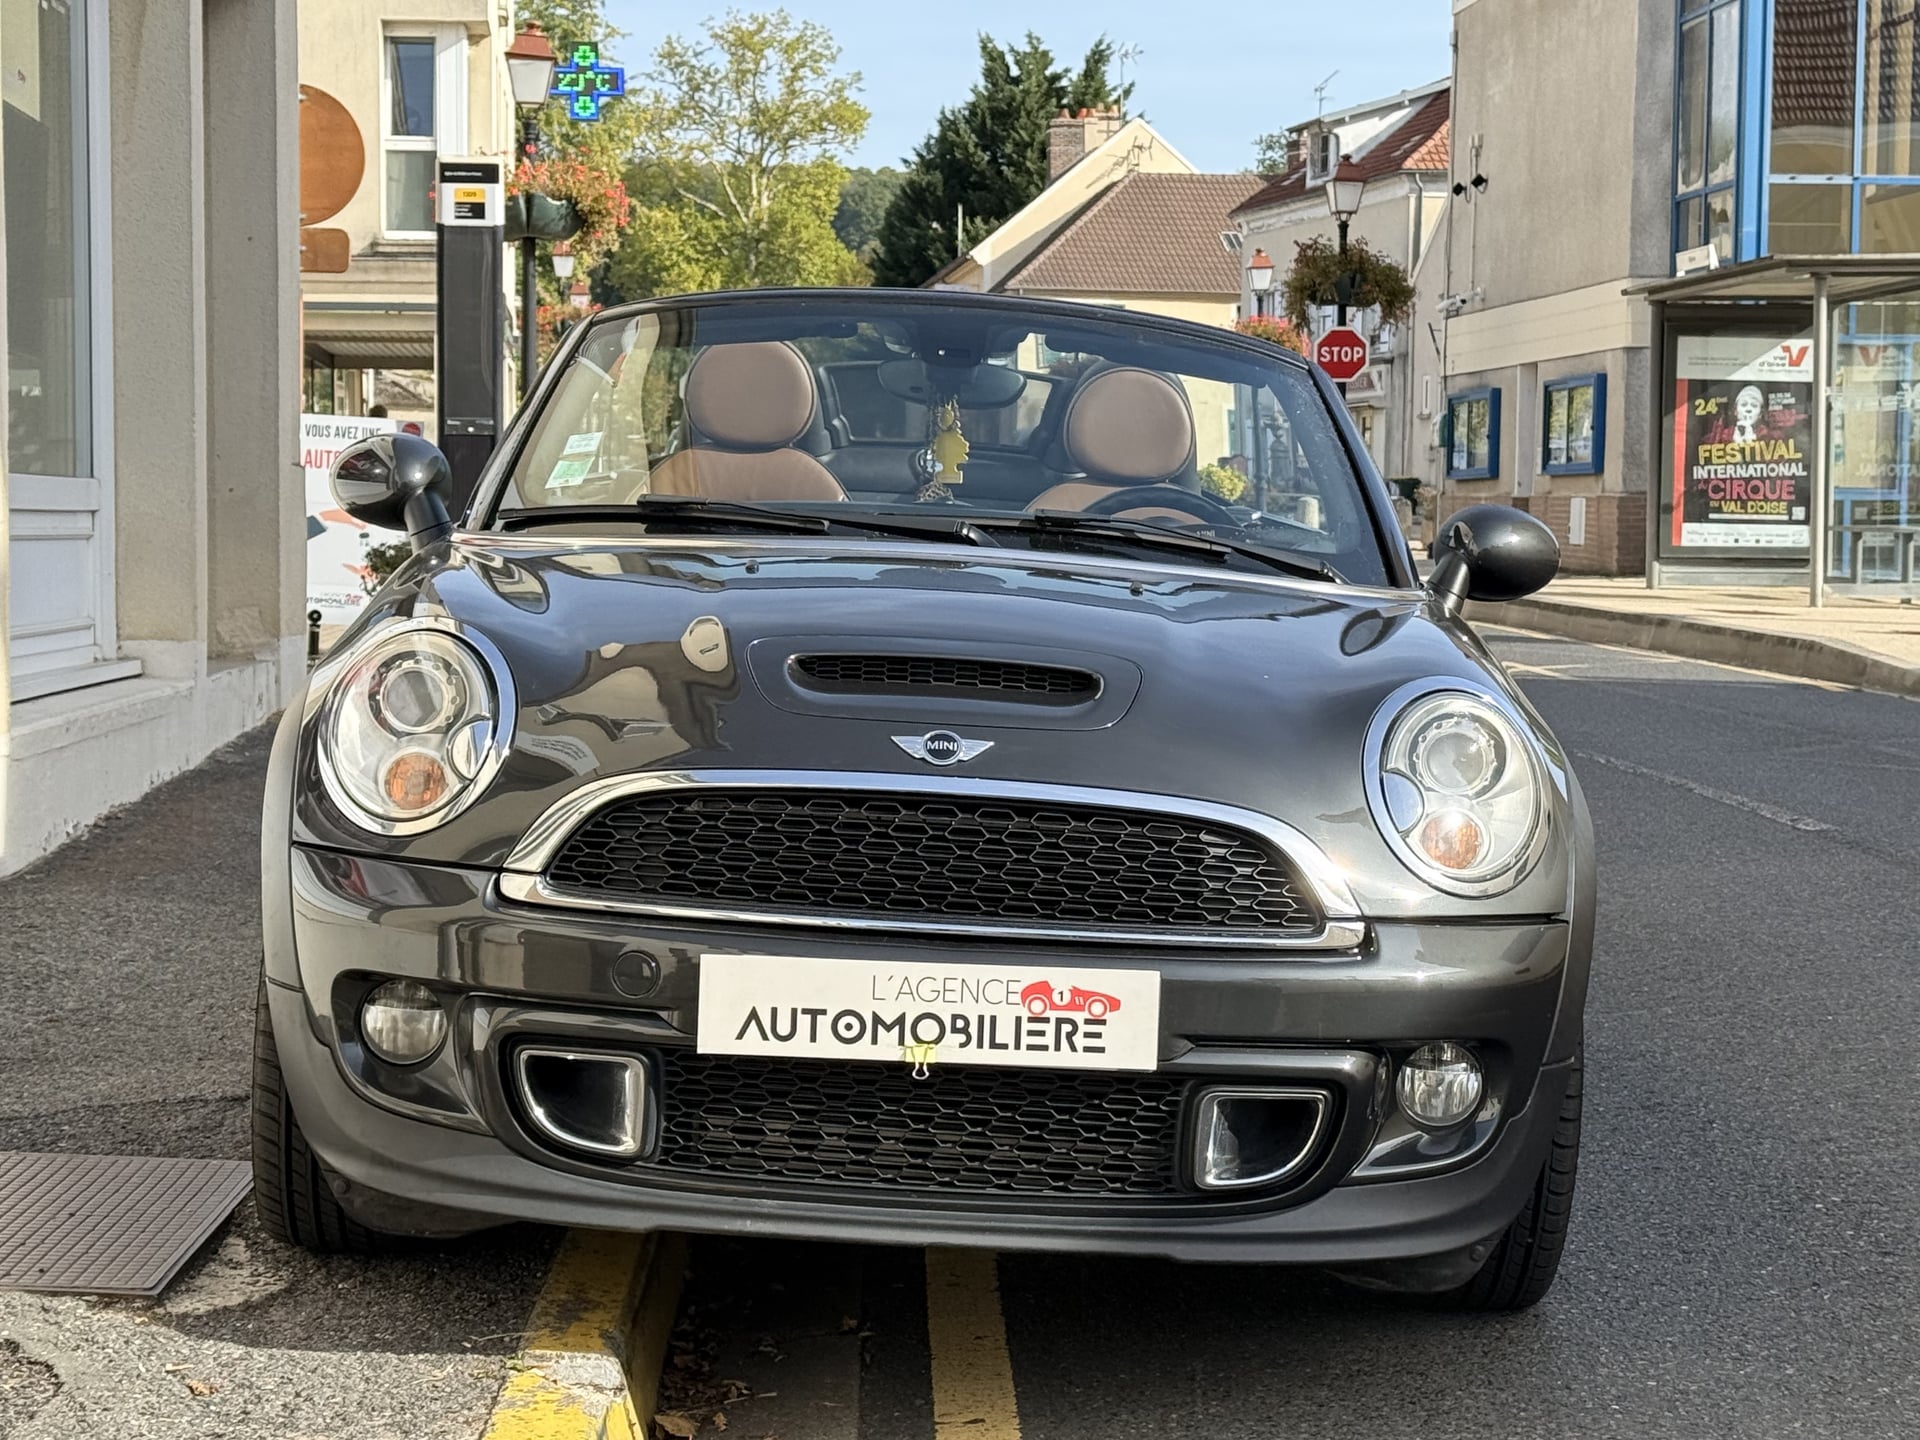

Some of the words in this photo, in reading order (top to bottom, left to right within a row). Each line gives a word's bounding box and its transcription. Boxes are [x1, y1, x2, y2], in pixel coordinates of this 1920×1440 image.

[1320, 346, 1363, 362] STOP
[305, 423, 331, 438] VOUS
[333, 425, 359, 440] AVEZ
[1698, 438, 1803, 465] FESTIVAL
[1693, 462, 1807, 479] INTERNATIONAL
[1708, 479, 1795, 500] CIRQUE
[1721, 500, 1745, 513] VAL
[1747, 501, 1788, 514] D'OISE
[926, 740, 958, 752] MINI
[872, 974, 1021, 1006] L'AGENCE
[1056, 991, 1066, 1002] 1
[735, 1005, 1107, 1054] AUTOMOBILIERE
